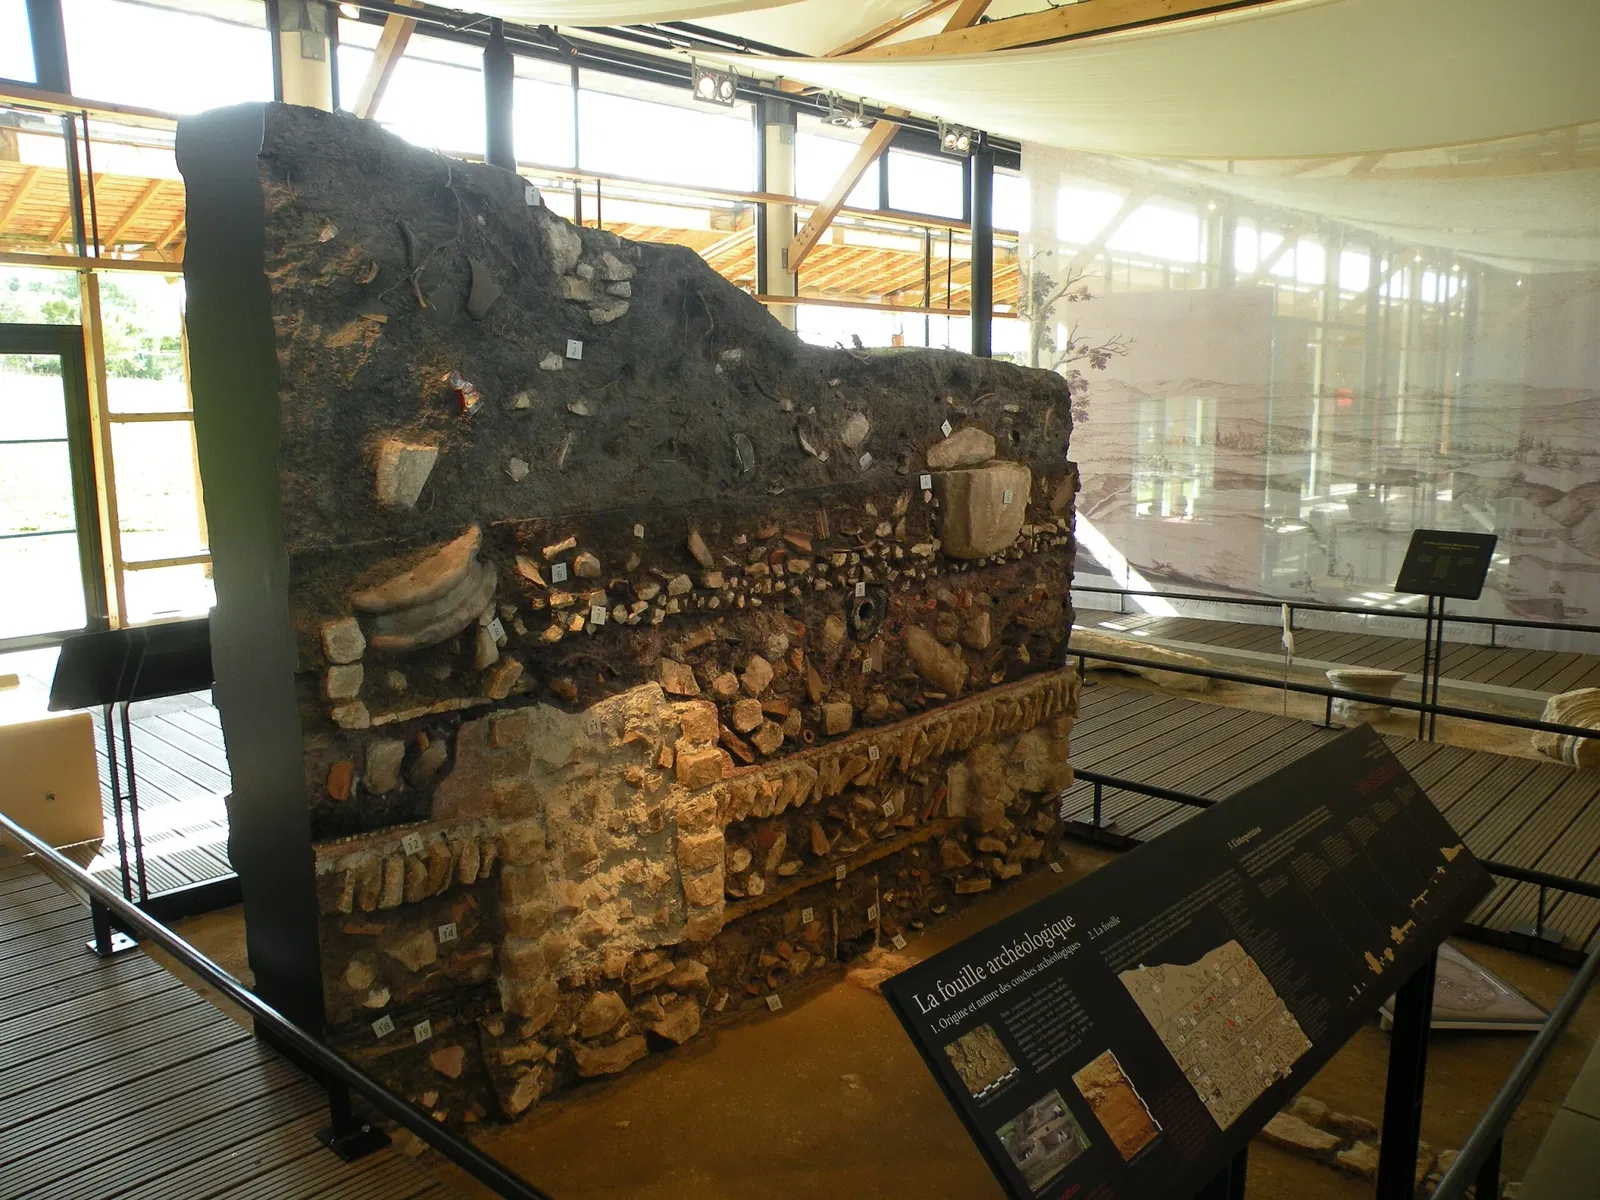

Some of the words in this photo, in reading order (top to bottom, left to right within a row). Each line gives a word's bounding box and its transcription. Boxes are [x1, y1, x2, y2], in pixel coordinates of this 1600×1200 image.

[408, 840, 419, 851] 12
[1087, 930, 1096, 940] 2.
[1093, 927, 1104, 936] La
[1101, 915, 1121, 932] fouille
[442, 929, 454, 941] 14
[911, 993, 940, 1015] La
[936, 963, 987, 1001] fouille
[985, 915, 1076, 974] archéologique
[930, 1024, 941, 1034] 1.
[938, 1007, 969, 1029] Origine
[968, 1002, 978, 1013] et
[976, 989, 1000, 1008] nature
[998, 982, 1012, 995] des
[1010, 966, 1038, 988] couches
[1036, 940, 1082, 972] archéologiques
[378, 1021, 391, 1034] 18
[418, 1028, 429, 1039] 19
